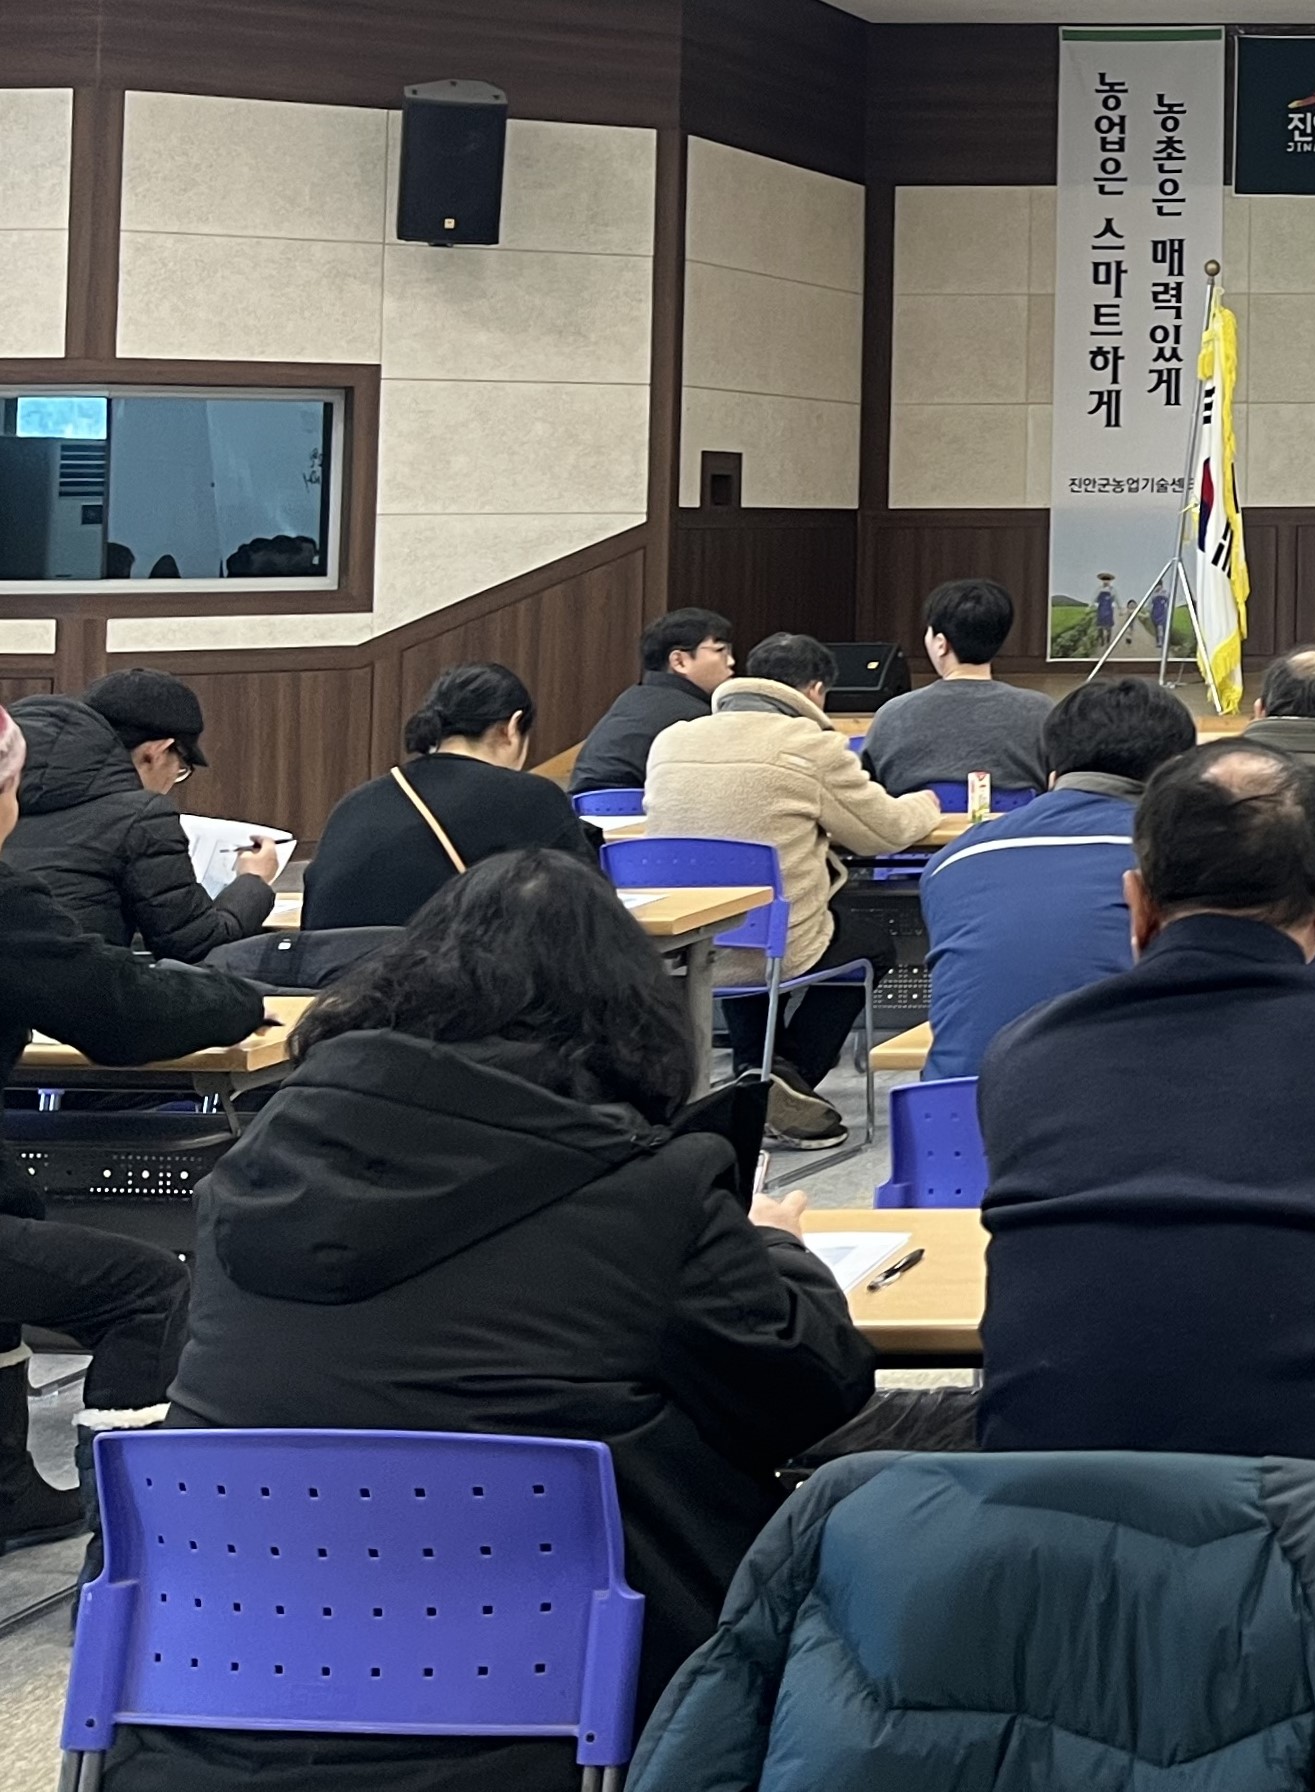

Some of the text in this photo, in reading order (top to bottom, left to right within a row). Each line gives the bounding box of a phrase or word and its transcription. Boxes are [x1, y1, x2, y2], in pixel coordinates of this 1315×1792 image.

[1087, 71, 1129, 429] 농업은 스마트하게
[1147, 92, 1187, 407] 농촌은 매력있게
